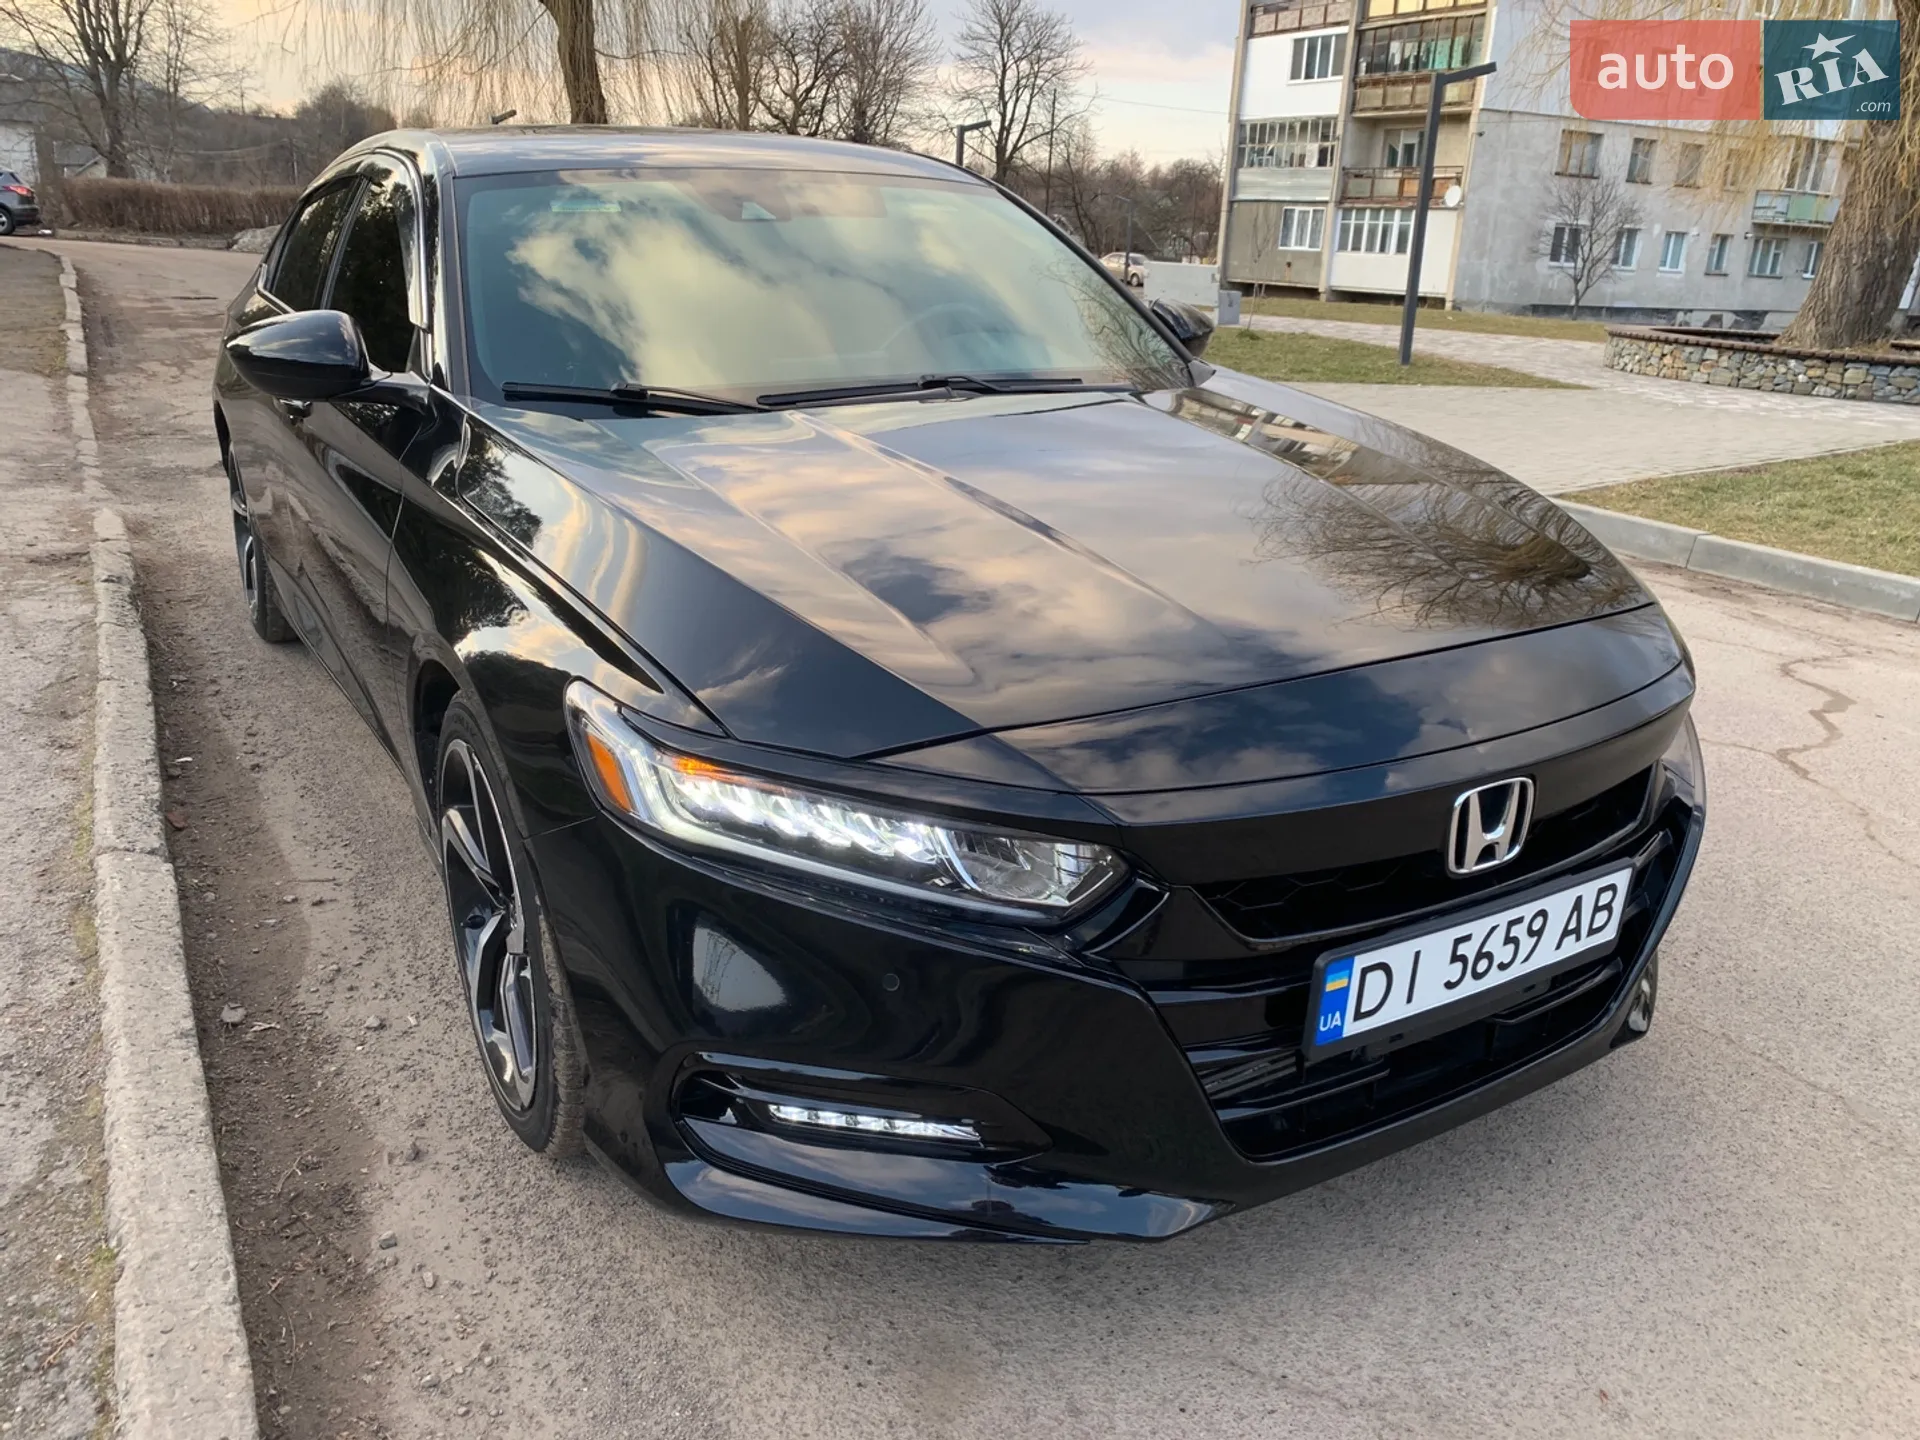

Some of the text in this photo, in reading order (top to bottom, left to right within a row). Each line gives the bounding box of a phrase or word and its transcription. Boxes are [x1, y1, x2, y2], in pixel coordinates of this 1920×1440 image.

[1353, 882, 1619, 1022] DI 5659 AB
[1319, 1010, 1342, 1032] UA
